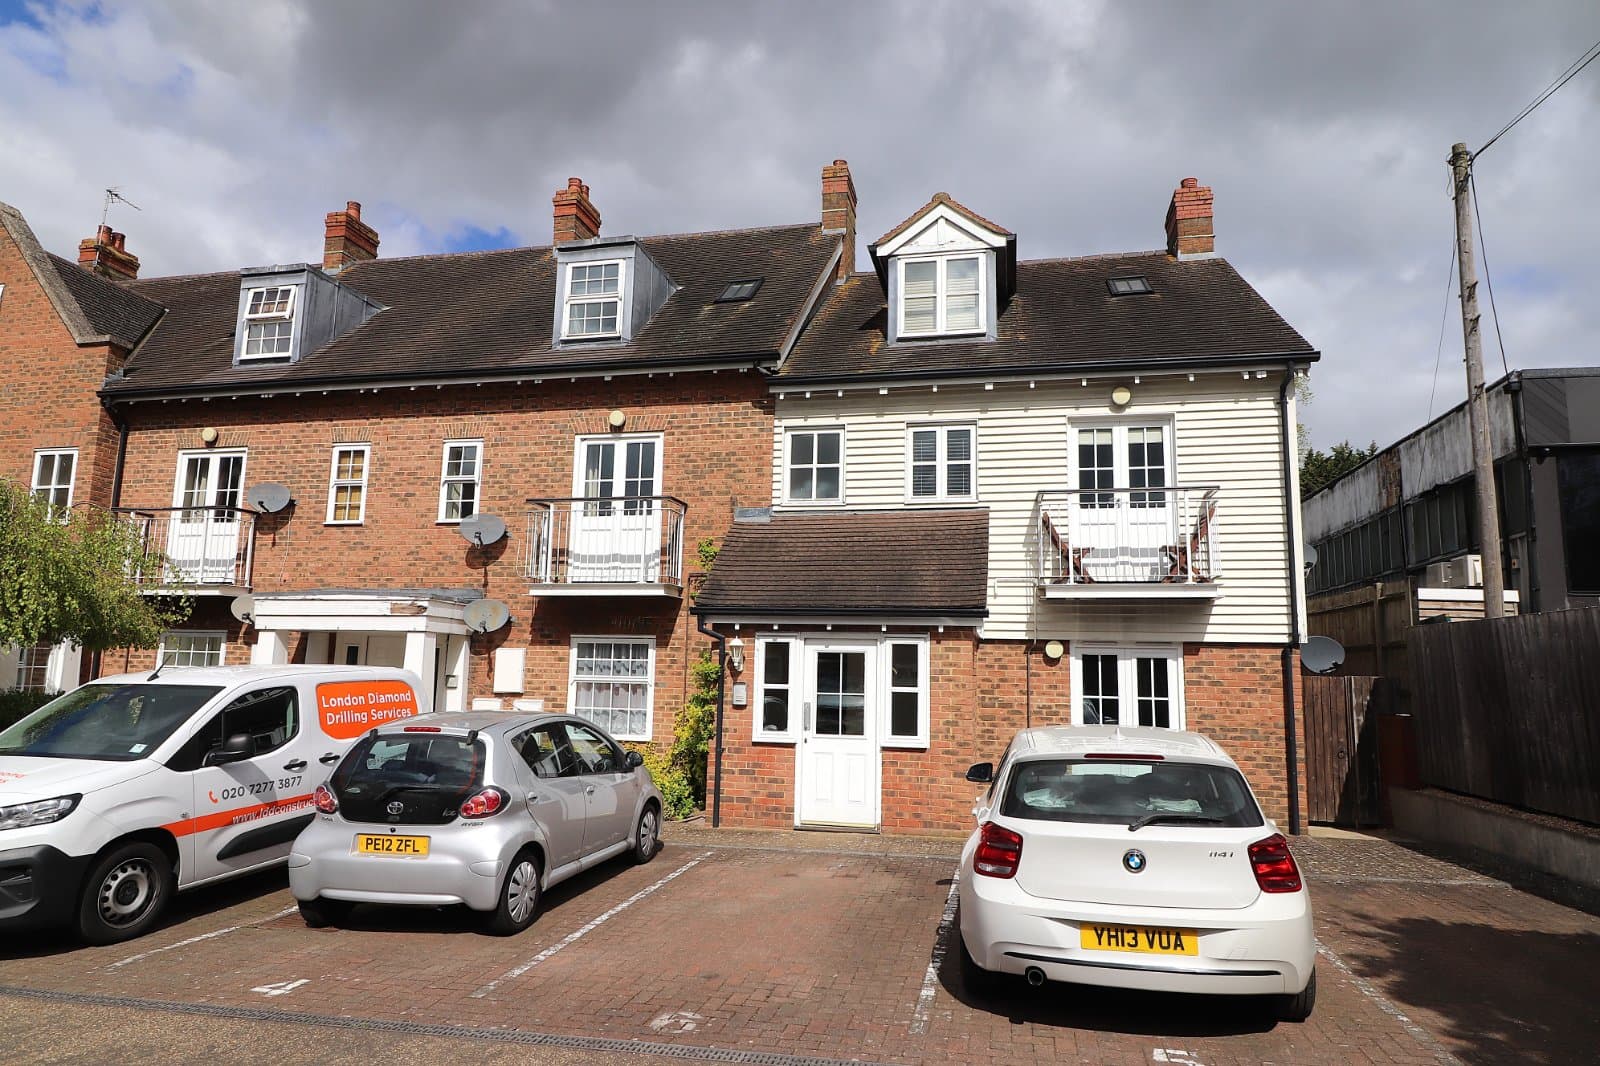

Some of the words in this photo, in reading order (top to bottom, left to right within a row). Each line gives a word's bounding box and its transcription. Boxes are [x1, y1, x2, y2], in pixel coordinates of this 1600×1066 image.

[322, 694, 365, 707] London
[367, 690, 411, 704] Diamond
[326, 711, 368, 725] Drilling
[370, 707, 411, 720] Services
[222, 786, 245, 800] 020
[249, 781, 274, 795] 7277
[278, 776, 302, 789] 3877
[366, 837, 392, 851] PE12
[396, 839, 420, 853] ZFL
[1094, 927, 1139, 948] YH13
[1147, 929, 1185, 951] VUA
